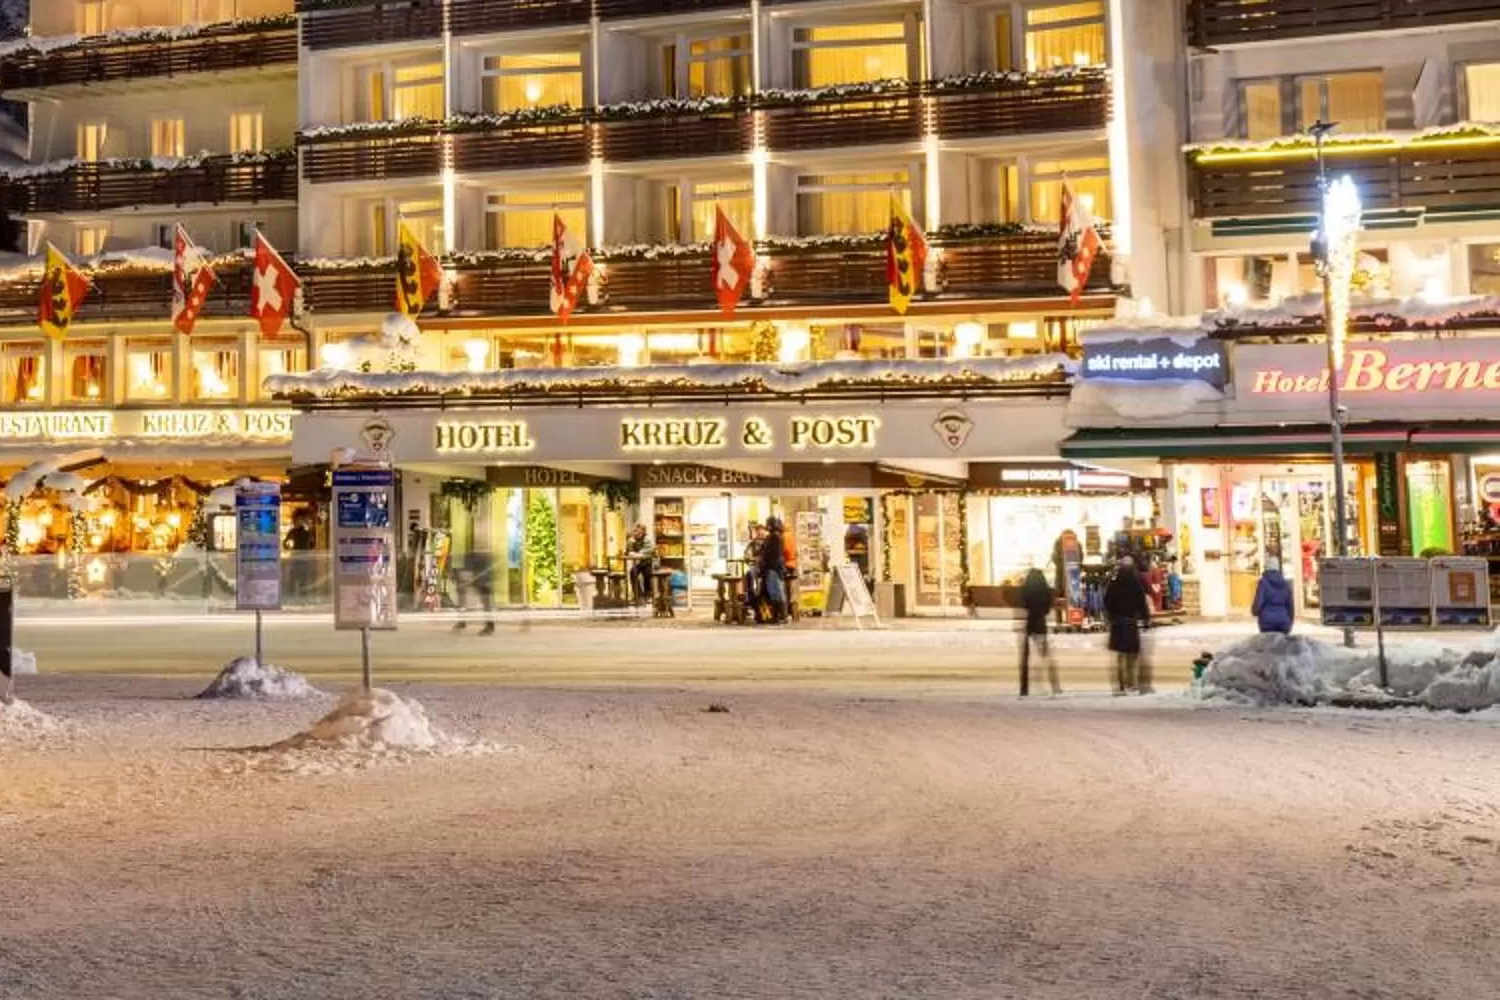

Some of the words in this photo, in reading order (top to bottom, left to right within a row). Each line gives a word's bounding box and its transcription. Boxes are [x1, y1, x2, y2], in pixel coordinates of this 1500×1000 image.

[1087, 354, 1111, 371] ski
[1112, 353, 1157, 370] rental
[1158, 356, 1171, 369] +
[1173, 352, 1220, 372] depot
[1252, 369, 1330, 393] Hotel
[142, 412, 209, 433] KREUZ
[216, 413, 232, 433] &
[620, 420, 722, 447] KREUZ
[742, 420, 769, 446] &
[790, 418, 876, 445] POST
[435, 424, 530, 449] HOTEL
[524, 467, 580, 484] HOTEL
[647, 467, 708, 484] SNACK
